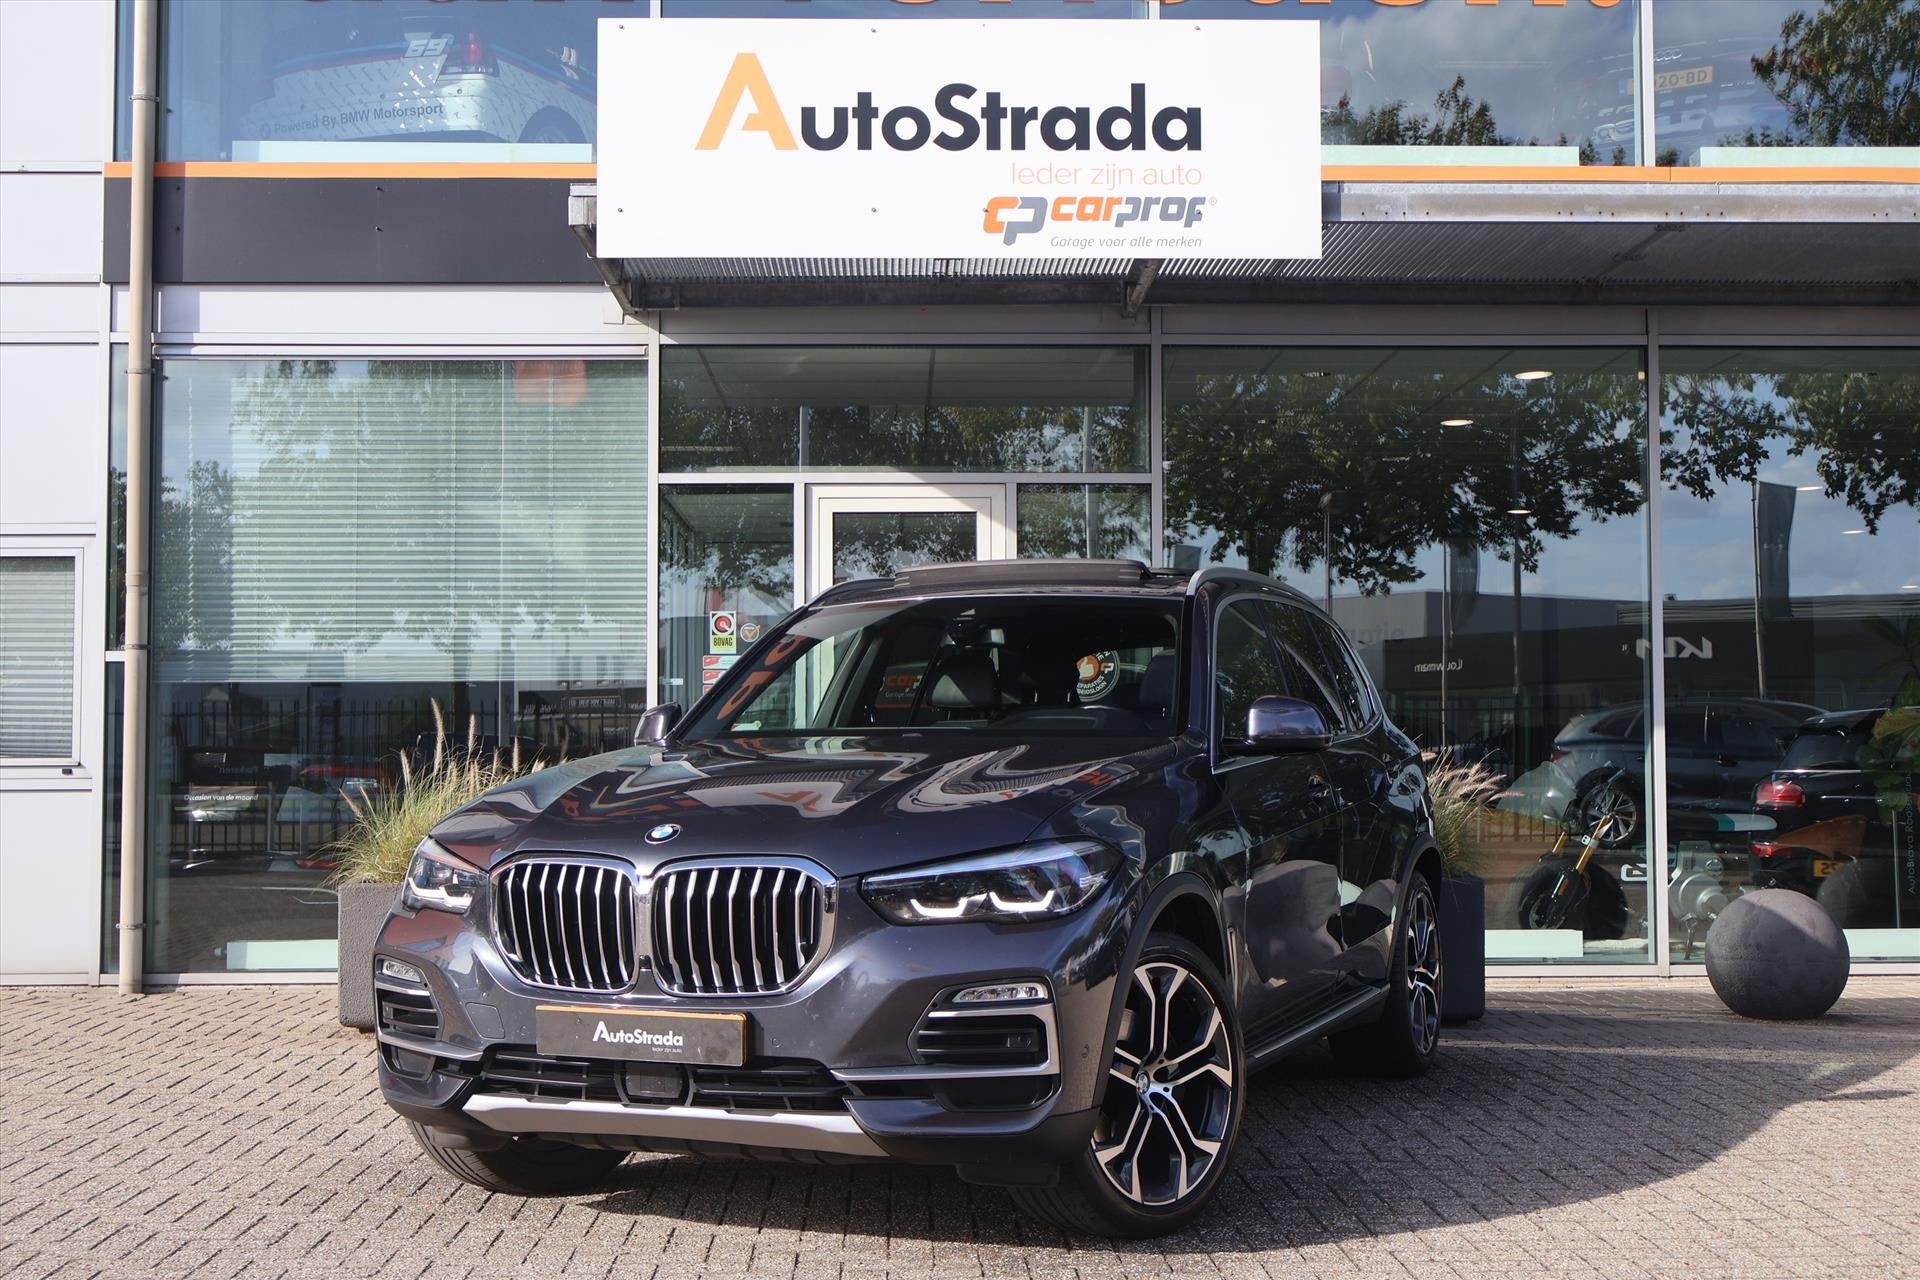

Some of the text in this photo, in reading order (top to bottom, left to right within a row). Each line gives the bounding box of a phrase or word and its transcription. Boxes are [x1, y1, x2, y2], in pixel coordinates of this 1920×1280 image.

[1655, 69, 1708, 89] 20-BD
[694, 52, 1202, 152] AutoStrada
[274, 103, 444, 134] Powered By BMW Motorsport
[1011, 162, 1203, 191] Ieder zijn auto
[1050, 235, 1203, 250] Garage voor alle merken
[713, 637, 733, 647] BOVAG
[1076, 675, 1105, 689] EPARATIES
[183, 793, 212, 801] Occasion
[225, 793, 235, 801] de
[235, 793, 259, 801] maand
[592, 1020, 684, 1046] AutoStrada
